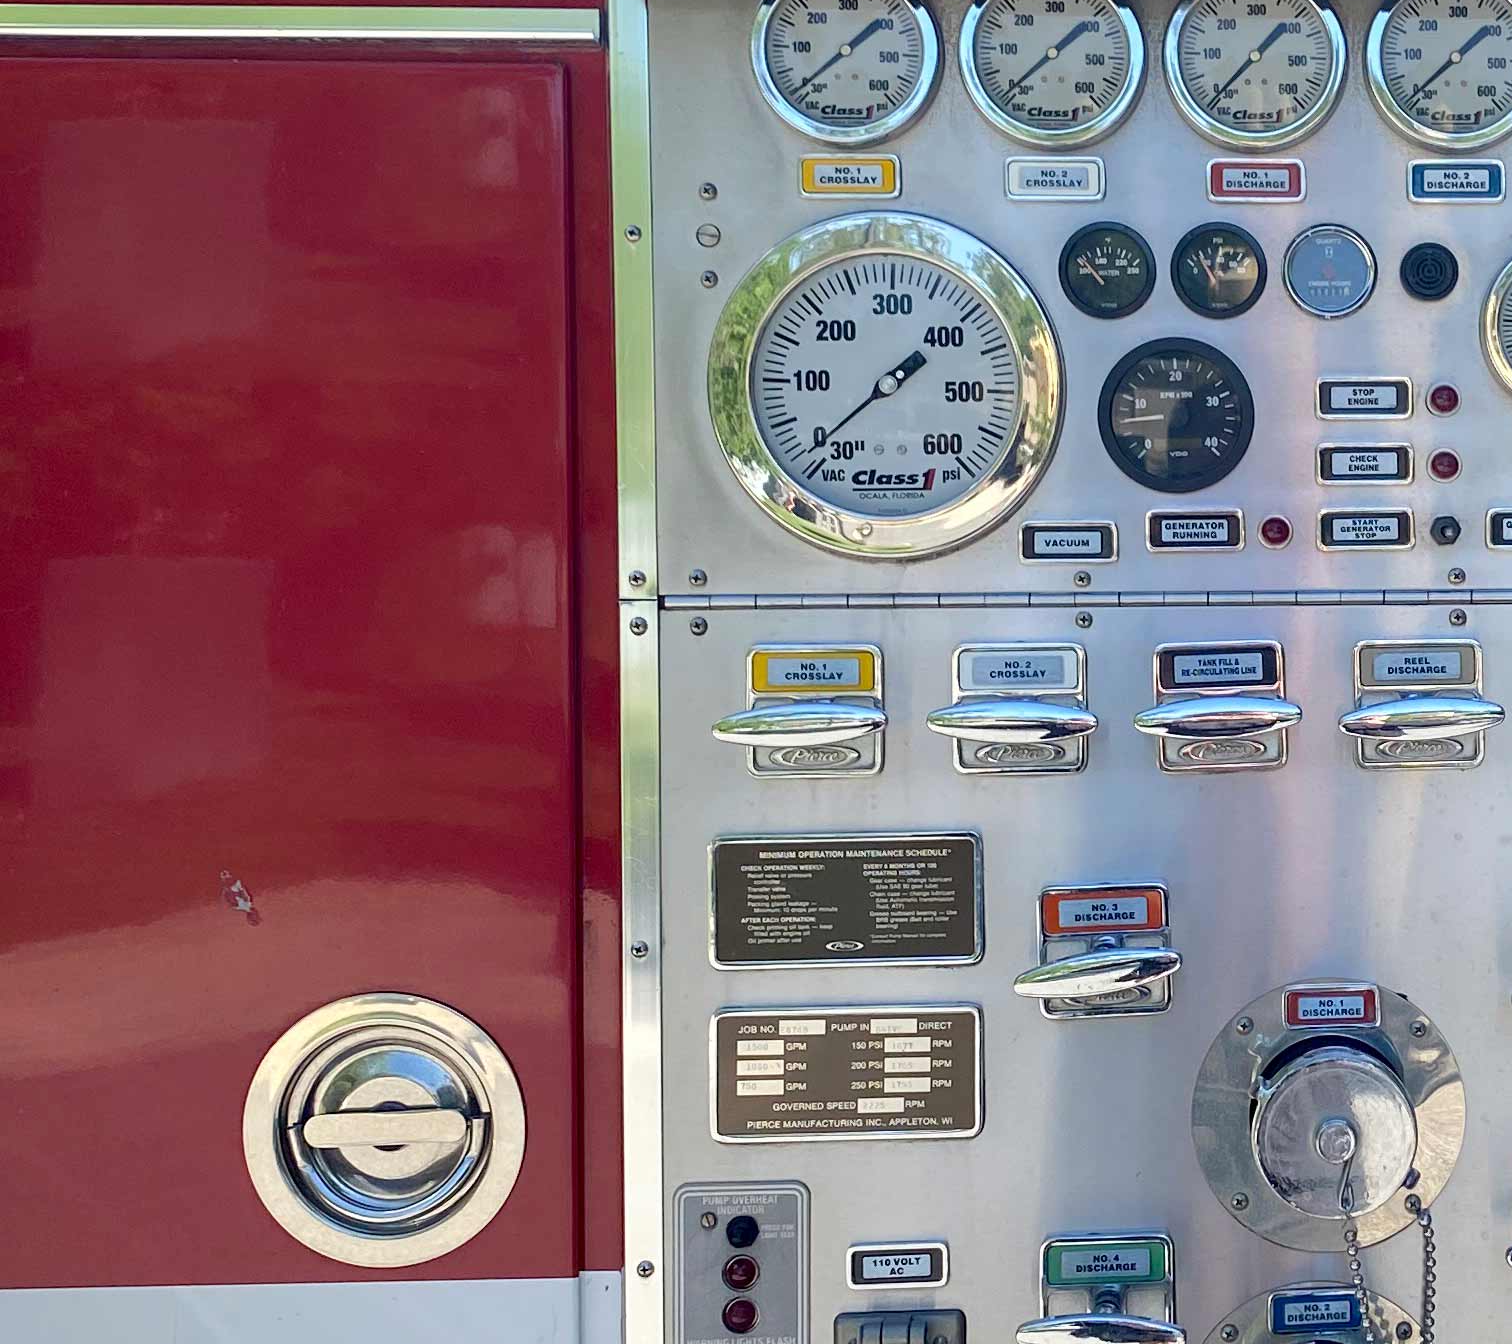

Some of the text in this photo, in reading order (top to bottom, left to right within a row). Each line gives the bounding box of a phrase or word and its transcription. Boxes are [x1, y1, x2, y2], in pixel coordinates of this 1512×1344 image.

[1041, 170, 1057, 178] NO.
[1243, 171, 1259, 179] NO.
[1443, 172, 1460, 180] NO.
[820, 176, 877, 184] CROSSLAY
[1026, 179, 1082, 187] CROSSLAY
[1226, 180, 1286, 188] DISCHARGE
[1427, 181, 1486, 189] DISCHARGE
[871, 293, 913, 316] 300
[815, 320, 856, 341] 200
[923, 327, 964, 348] 400
[793, 370, 831, 391] 100
[944, 381, 984, 402] 500
[923, 433, 962, 455] 600
[821, 467, 846, 482] VAC
[941, 466, 961, 483] psi
[1165, 522, 1224, 530] GENERATOR
[1172, 531, 1217, 539] RUNNING
[1045, 539, 1090, 547] VACUUM
[1005, 661, 1021, 669] NO.
[1404, 657, 1430, 665] REEL
[800, 663, 820, 671] NO.
[1387, 666, 1447, 674] DISCHARGE
[785, 672, 842, 680] CROSSLAY
[990, 670, 1045, 678] CROSSLAY
[1074, 913, 1135, 921] DISCHARGE
[1302, 1008, 1361, 1016] DISCHARGE
[869, 1041, 883, 1049] PSI
[772, 1103, 823, 1111] GOVERNED
[827, 1102, 856, 1110] SPEED
[747, 1121, 780, 1129] PIERCE
[942, 1117, 953, 1126] WI
[702, 1196, 778, 1205] PUMP OVERHEAT
[717, 1205, 764, 1215] INDICATOR
[873, 1257, 920, 1267] 110 VOLT
[1093, 1255, 1109, 1263] NO.
[890, 1267, 904, 1275] AC
[1076, 1264, 1136, 1272] DISCHARGE
